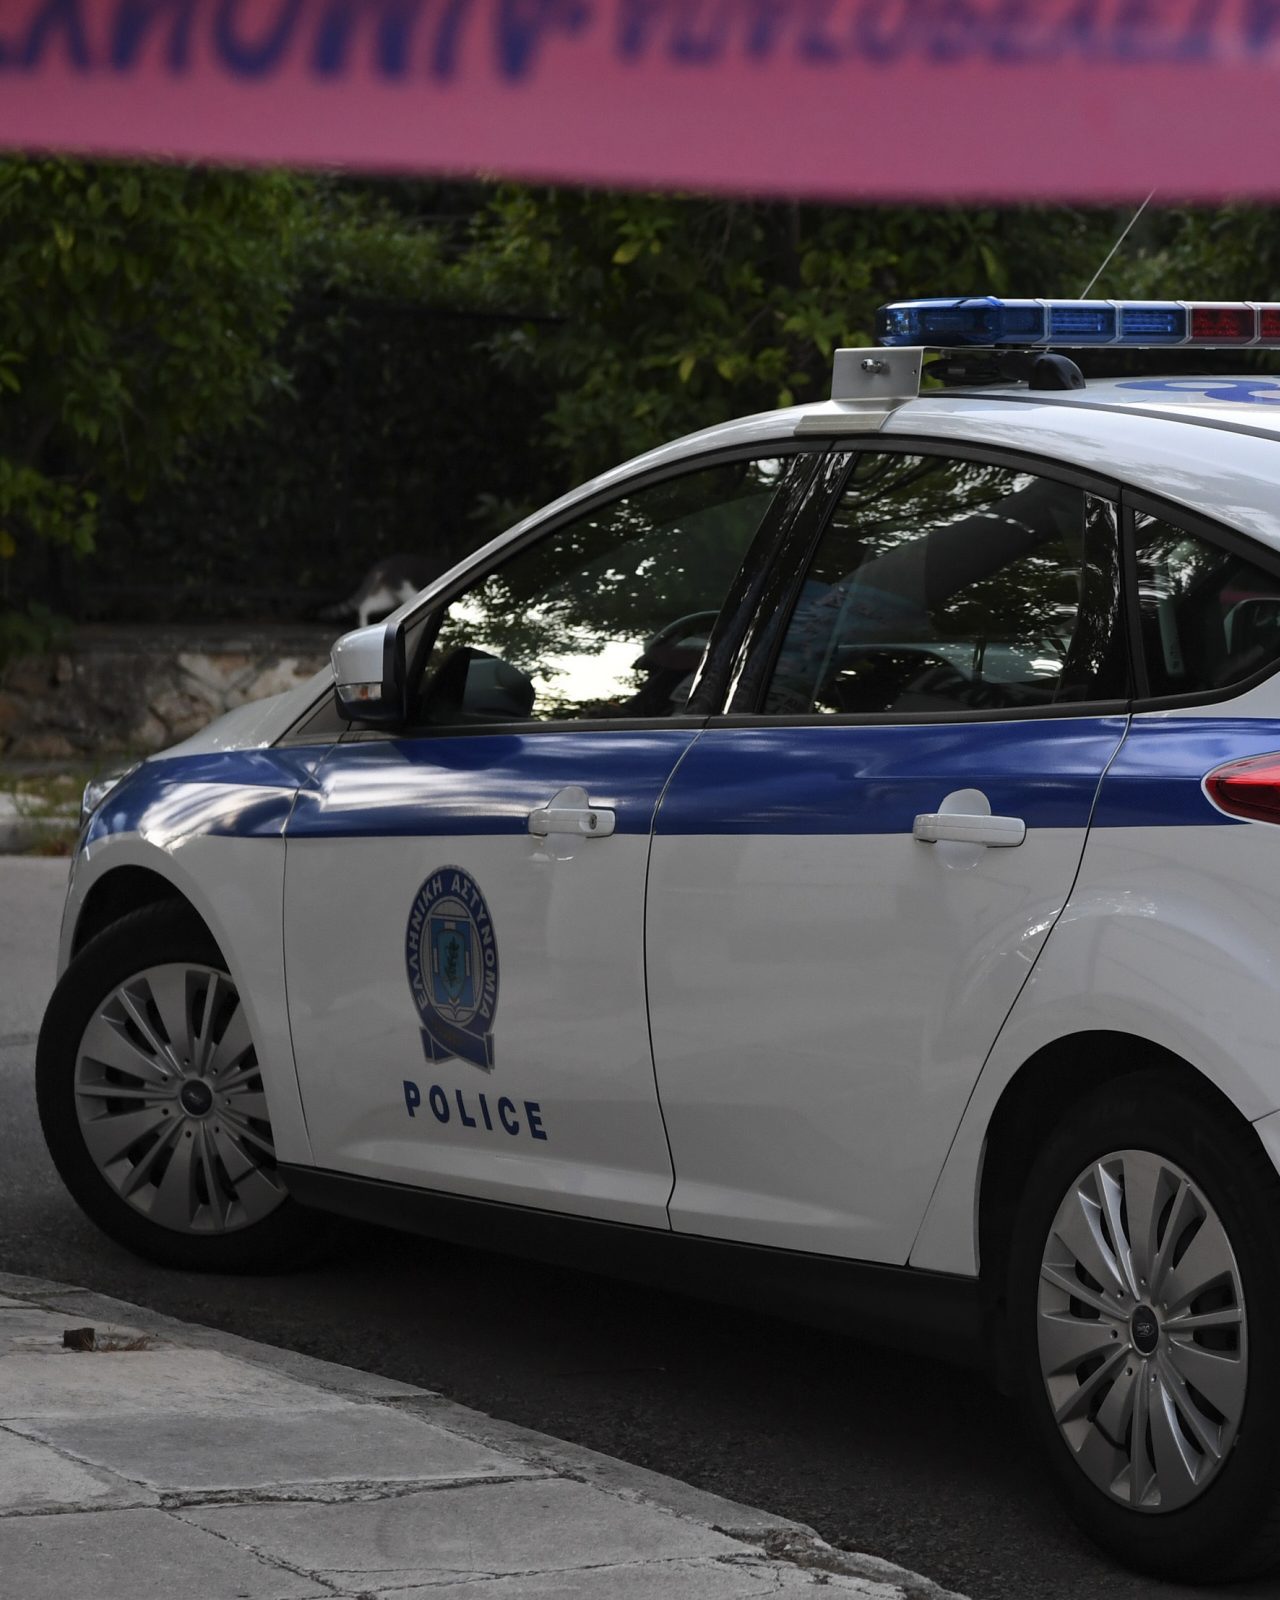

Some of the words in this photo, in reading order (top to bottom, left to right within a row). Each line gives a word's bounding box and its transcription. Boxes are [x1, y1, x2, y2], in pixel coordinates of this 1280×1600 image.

[407, 873, 443, 1010] ΕΛΛΗΝΙΚΗ
[451, 873, 497, 1019] ΑΣΤΥΝΟΜΙΑ
[402, 1079, 548, 1141] POLICE
